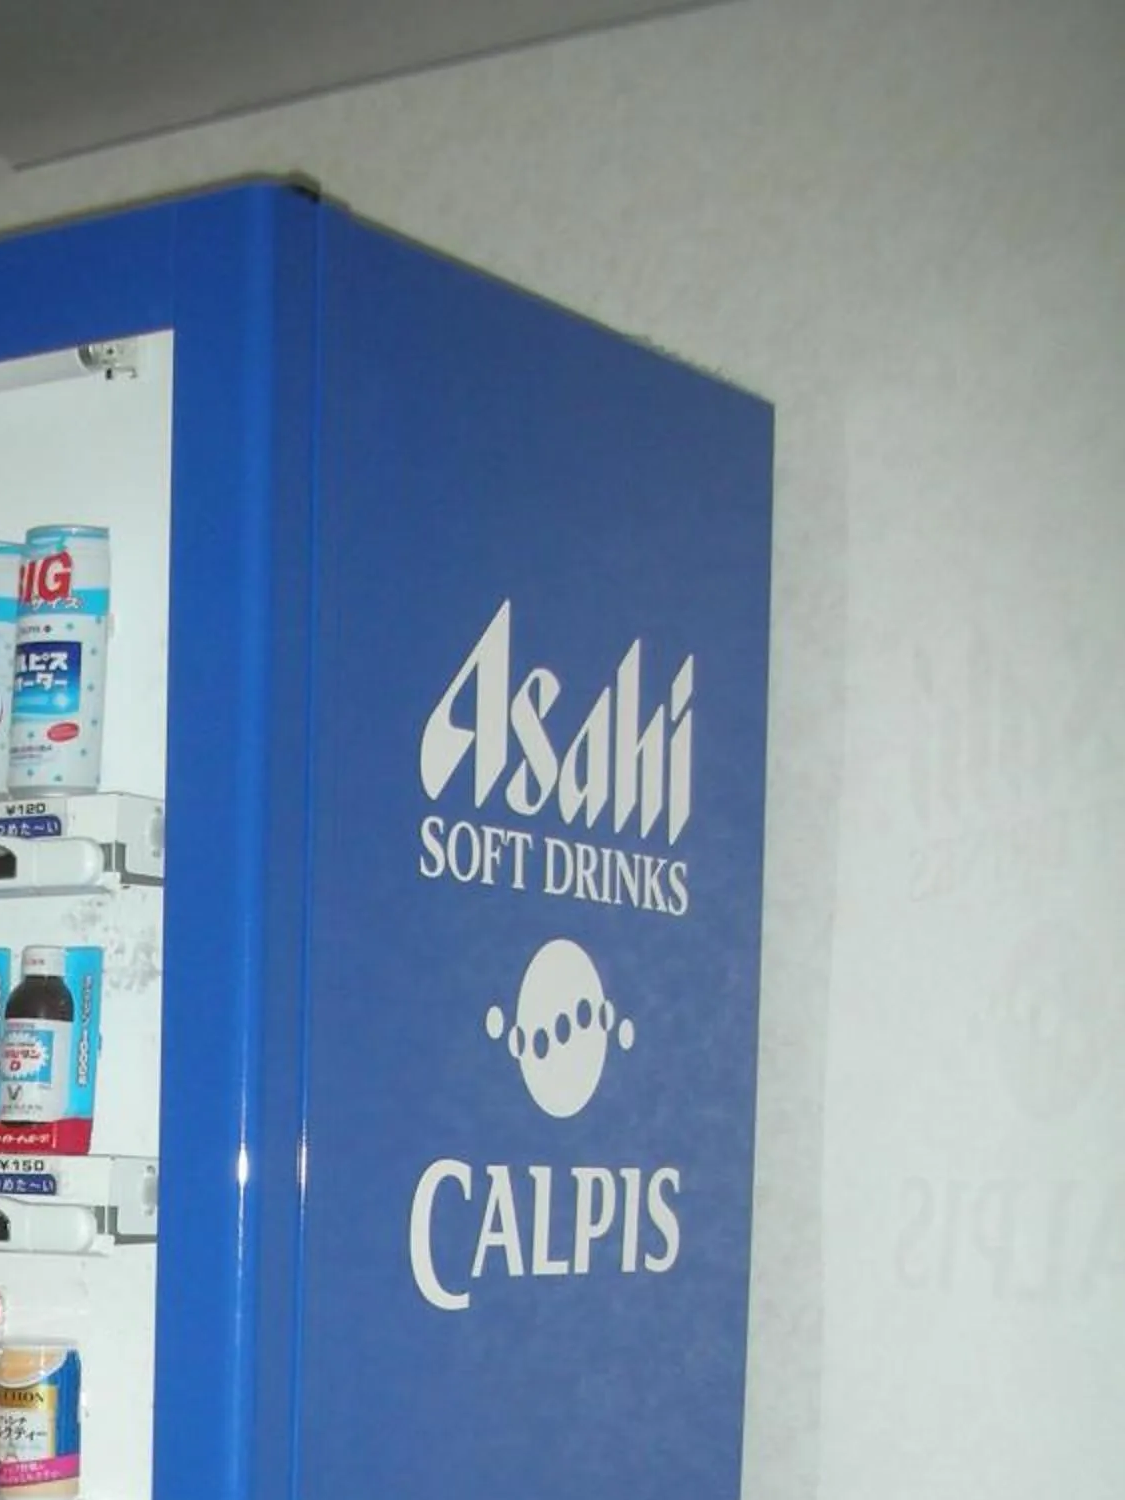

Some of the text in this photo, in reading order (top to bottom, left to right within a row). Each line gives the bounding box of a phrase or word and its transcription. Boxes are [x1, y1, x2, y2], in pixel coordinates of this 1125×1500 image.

[420, 598, 694, 847] Asahi
[6, 803, 46, 815] ¥120
[420, 815, 689, 917] SOFT DRINKS
[0, 1159, 44, 1172] ¥150
[410, 1159, 681, 1310] CALPIS
